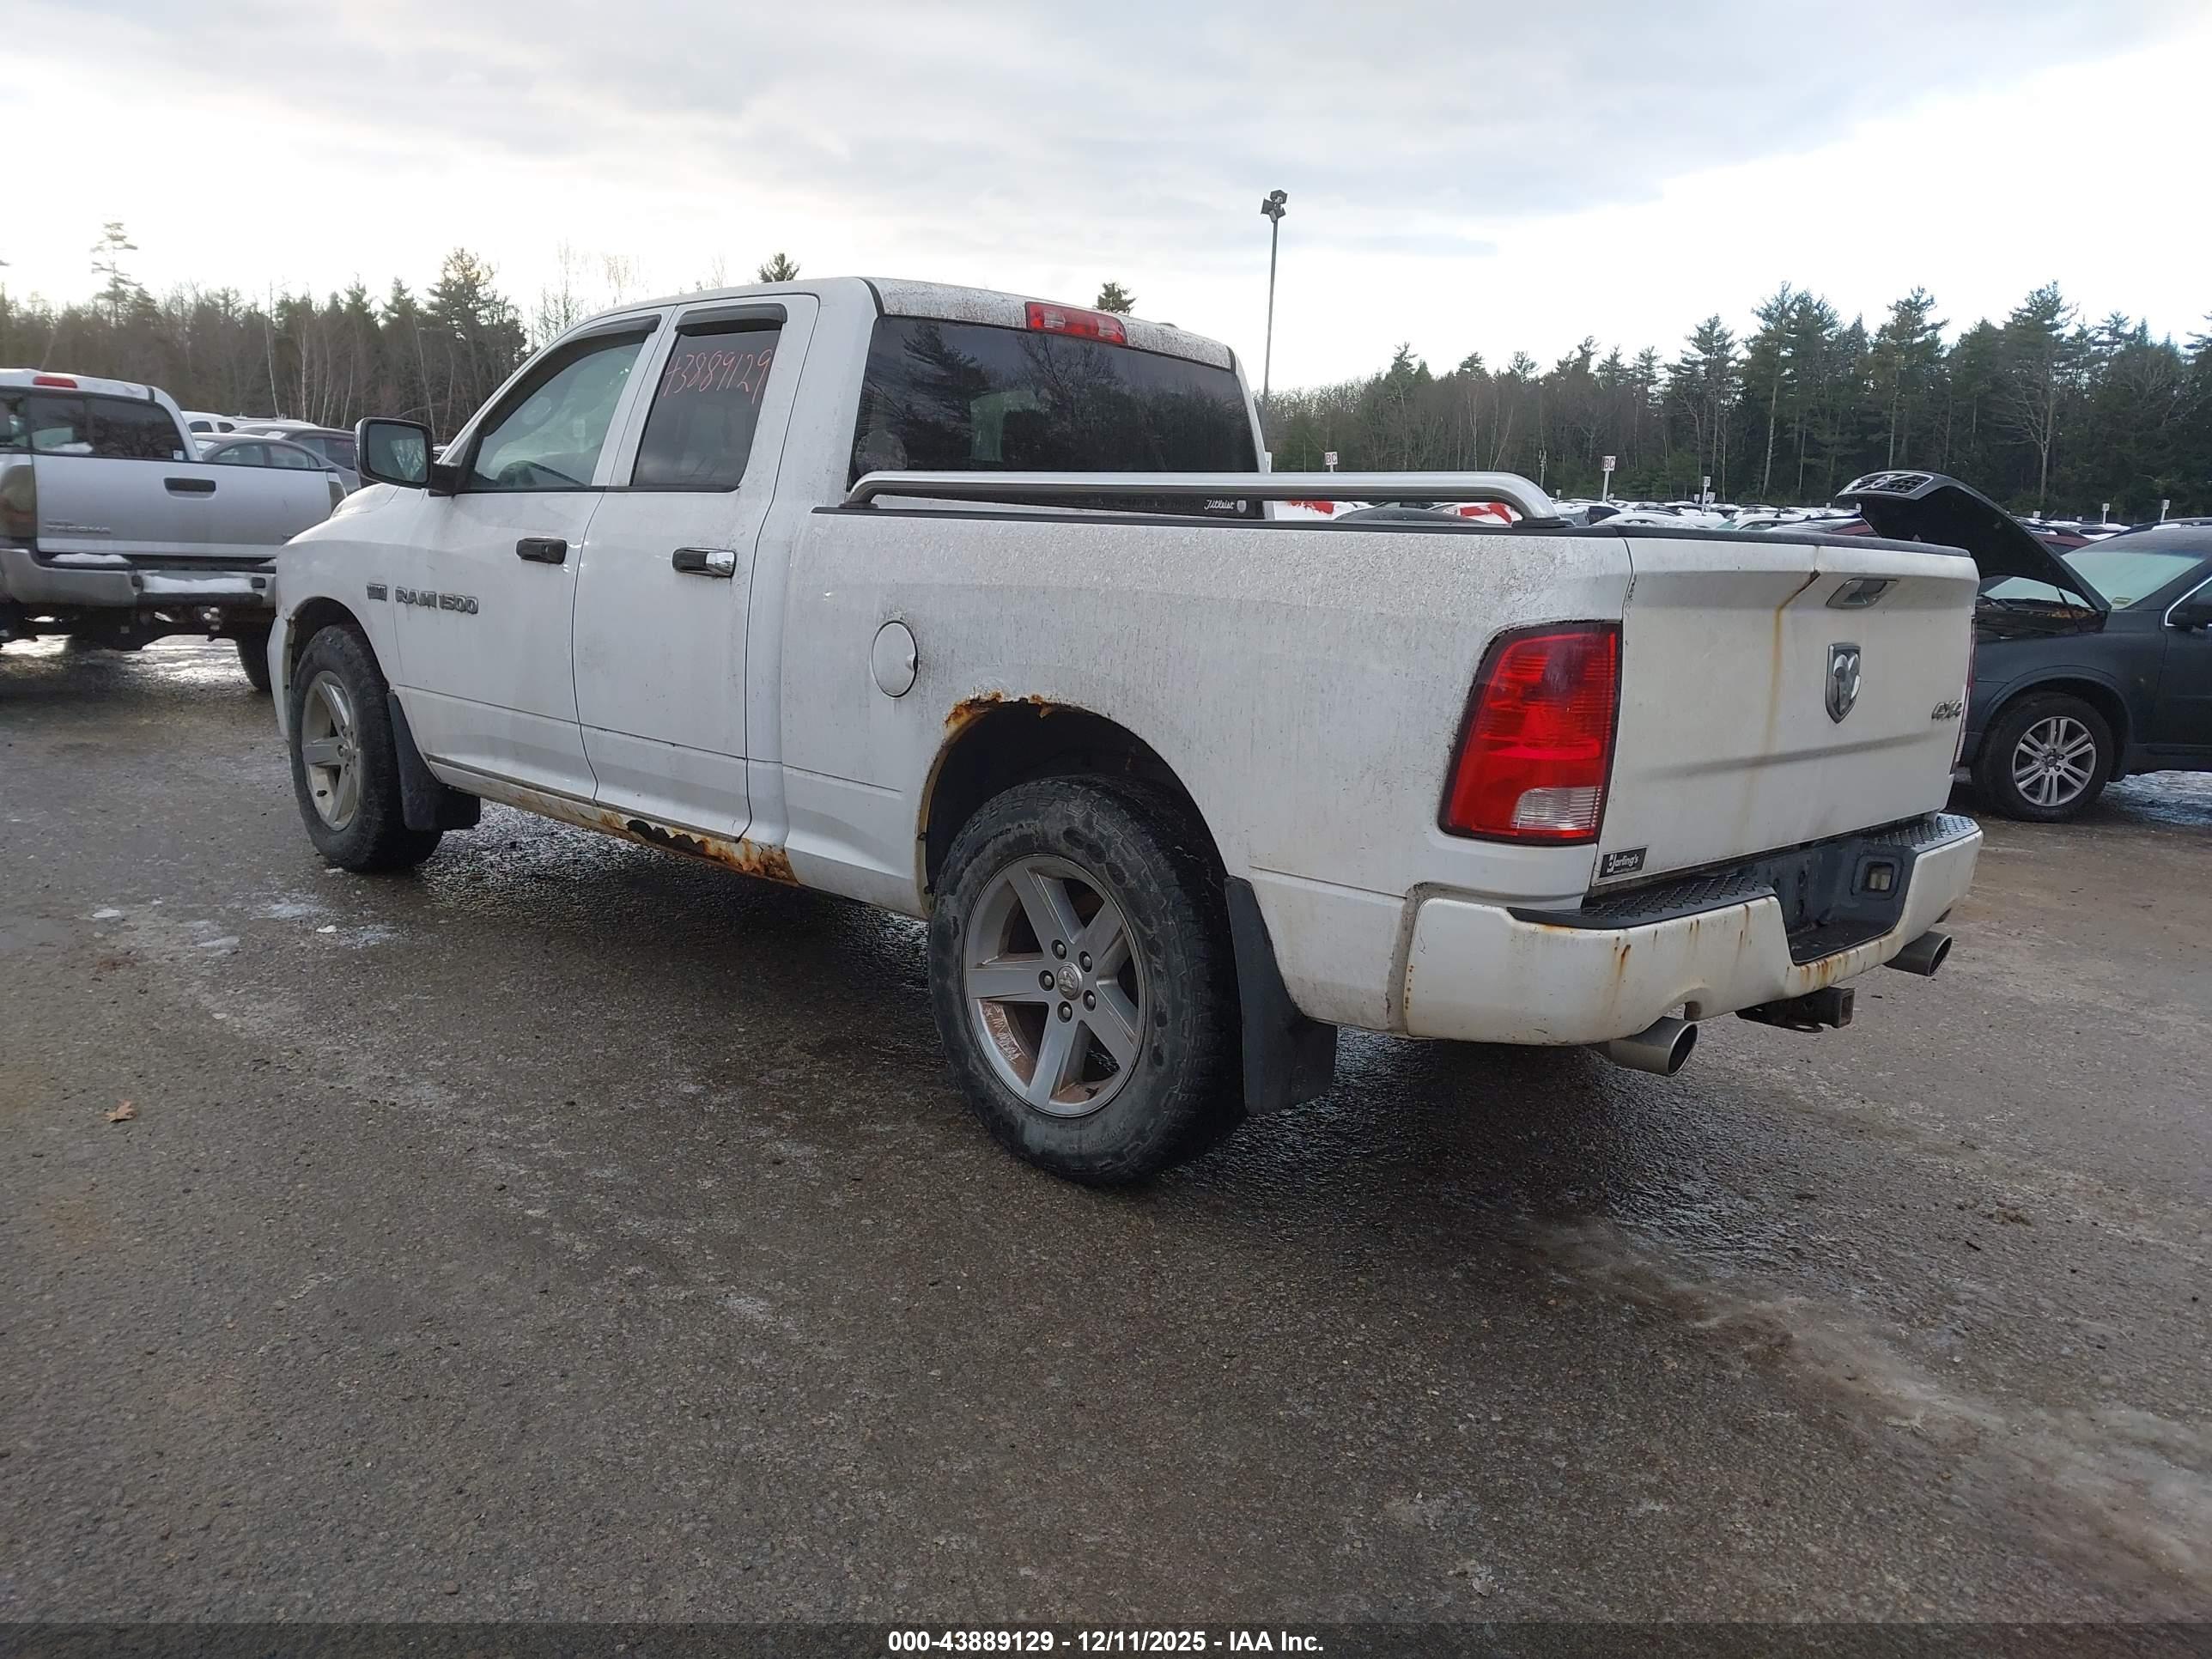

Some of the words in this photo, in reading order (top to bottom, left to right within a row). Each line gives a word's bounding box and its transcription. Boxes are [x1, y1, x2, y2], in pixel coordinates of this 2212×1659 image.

[664, 349, 773, 404] 43889129
[395, 586, 437, 608] RAM
[439, 592, 478, 614] 1500
